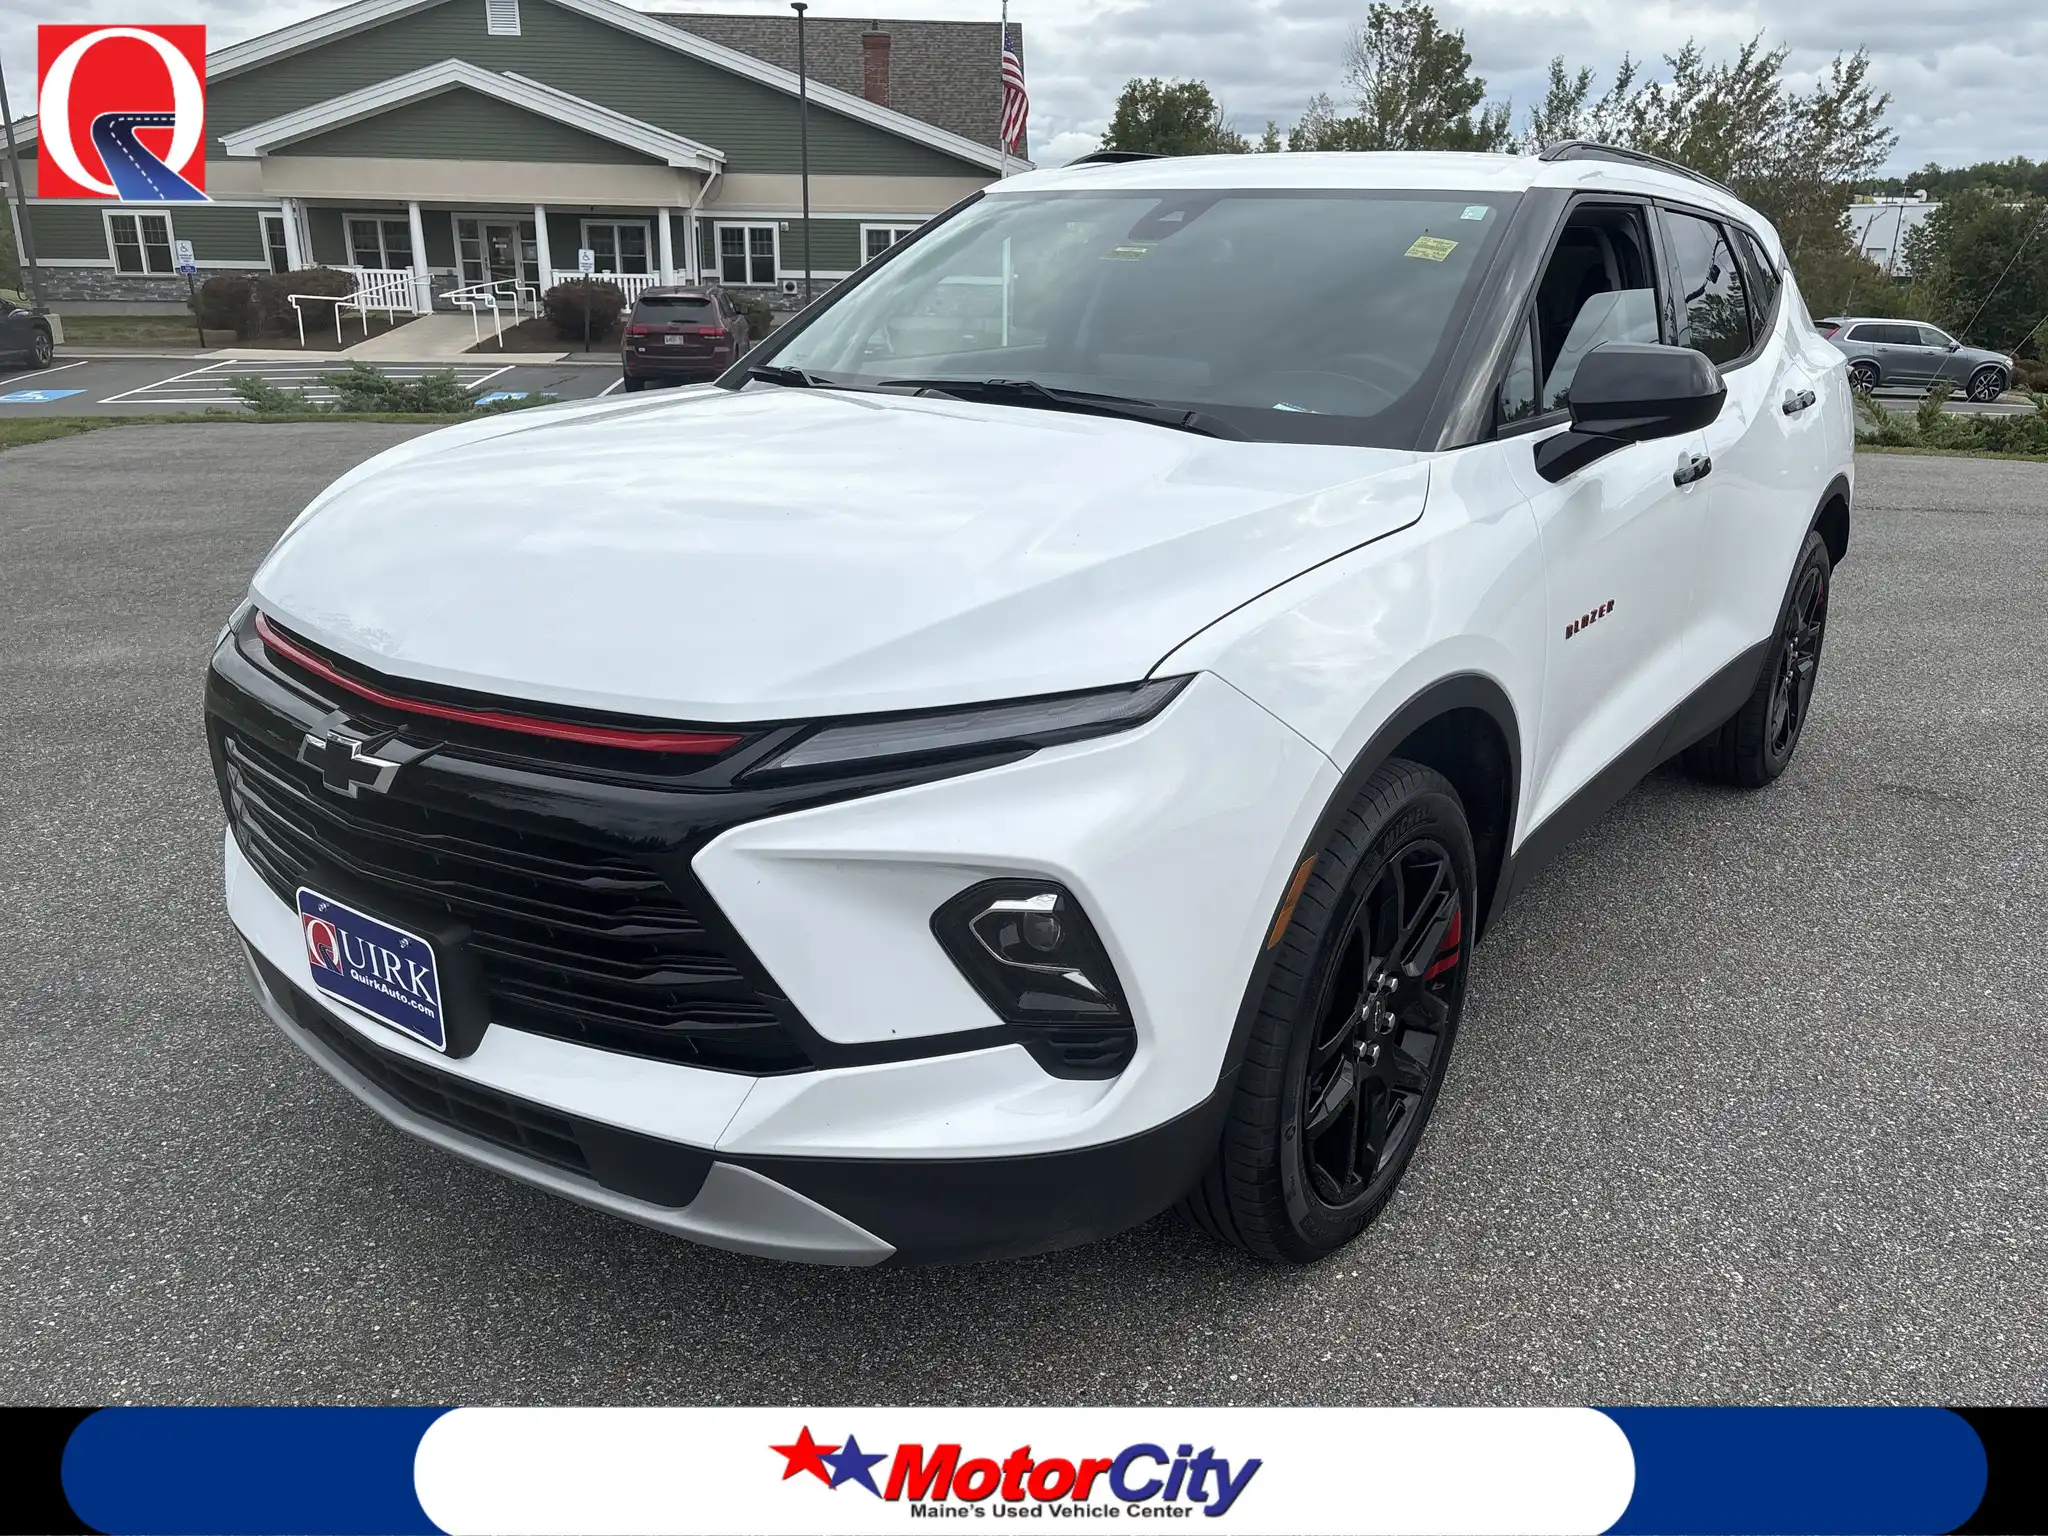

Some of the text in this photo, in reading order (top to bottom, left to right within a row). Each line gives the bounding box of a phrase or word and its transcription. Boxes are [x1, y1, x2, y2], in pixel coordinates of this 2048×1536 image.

[1565, 598, 1615, 640] BLAZER
[306, 919, 437, 1007] QUIRK
[350, 969, 435, 1019] QuirkAuto.com
